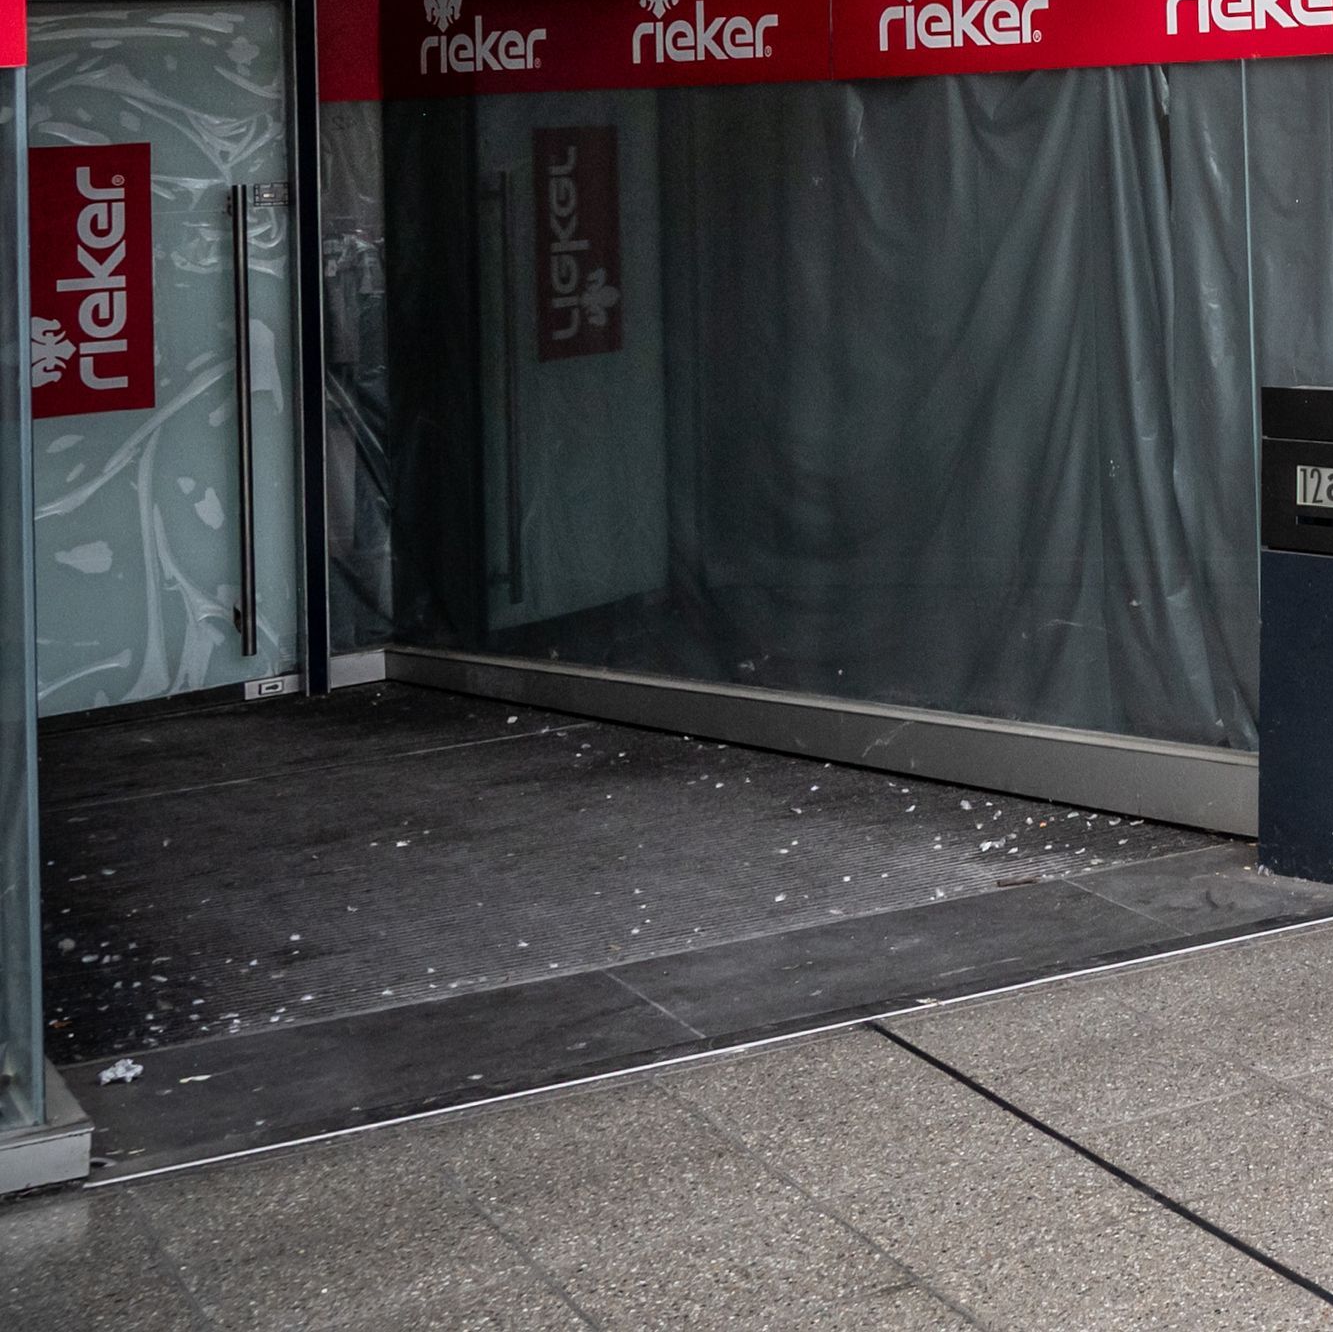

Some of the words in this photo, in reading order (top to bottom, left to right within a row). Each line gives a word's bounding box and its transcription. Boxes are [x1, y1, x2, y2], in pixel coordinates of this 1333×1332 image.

[420, 16, 547, 74] rieker
[632, 0, 779, 63] rieker
[56, 167, 129, 390] rieker
